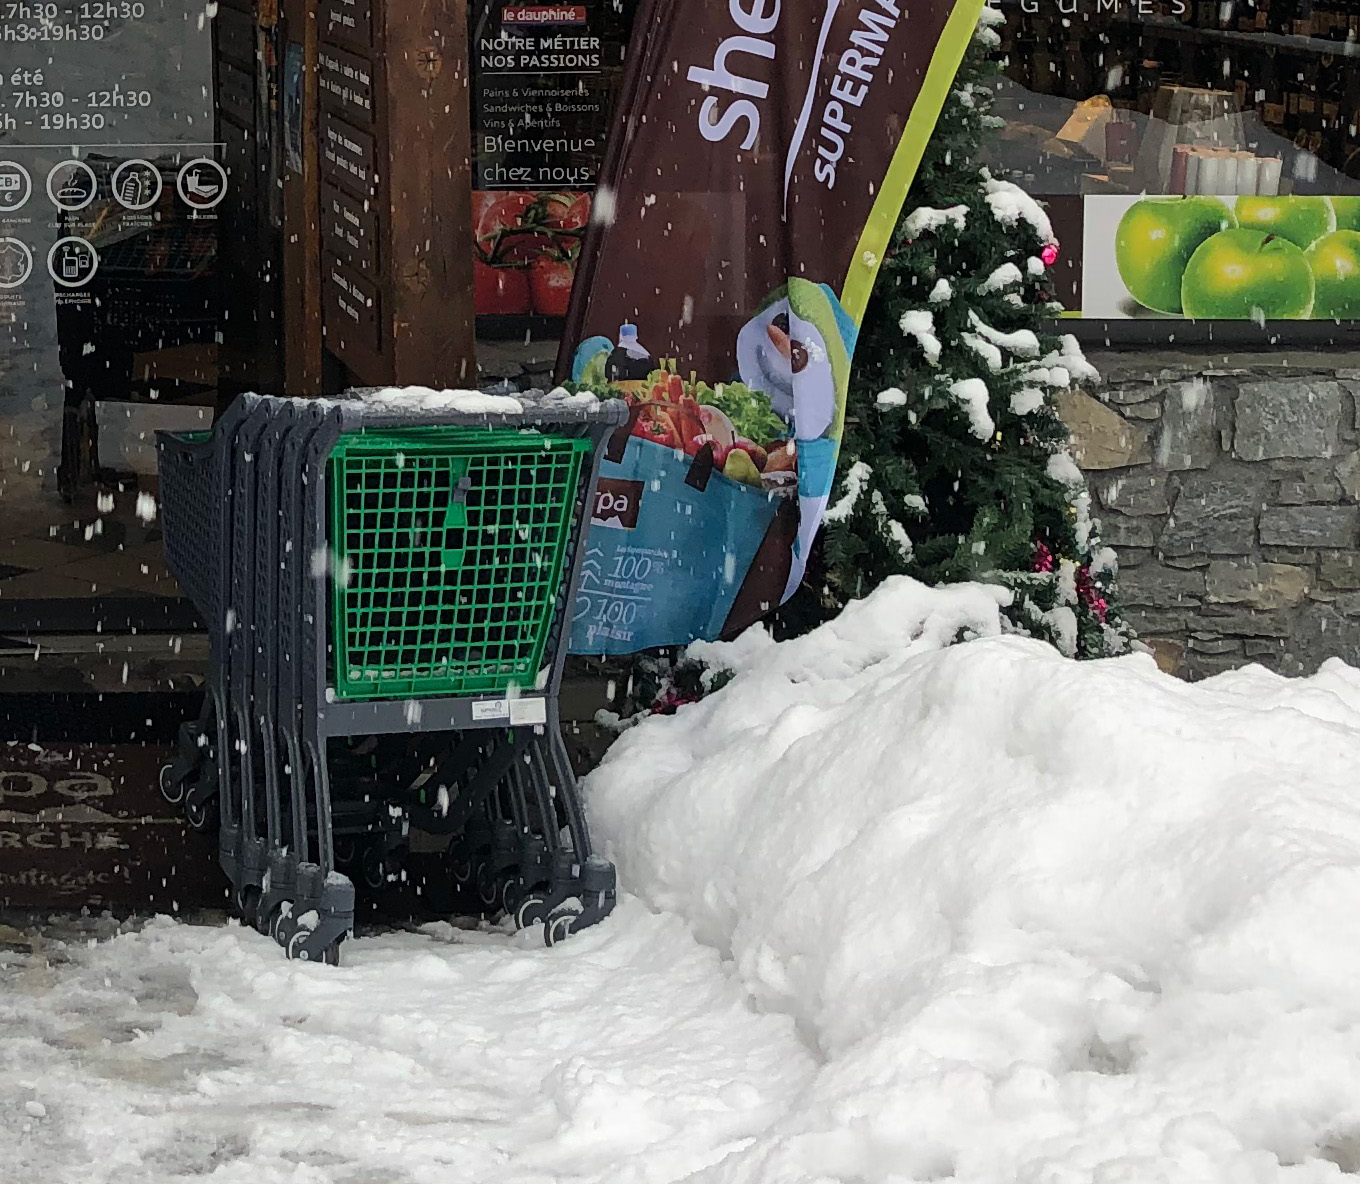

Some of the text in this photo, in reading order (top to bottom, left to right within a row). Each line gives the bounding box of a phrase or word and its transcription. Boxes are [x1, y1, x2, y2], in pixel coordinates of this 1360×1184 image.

[80, 1, 146, 20] 12h30
[503, 7, 576, 23] le dauphiné
[480, 34, 600, 51] NOTRE MÉTIER
[480, 54, 600, 68] NOS PASSIONS
[10, 67, 44, 86] été
[12, 91, 64, 108] 7h30
[87, 90, 152, 108] 12h30
[482, 88, 510, 97] Pains
[521, 87, 590, 97] Viennoiseries
[482, 103, 543, 113] Sandwiches
[554, 102, 600, 112] Boissons
[40, 113, 106, 131] 19h30
[482, 119, 506, 128] Vins
[484, 135, 596, 153] Bienvenue
[483, 162, 590, 181] chez nous
